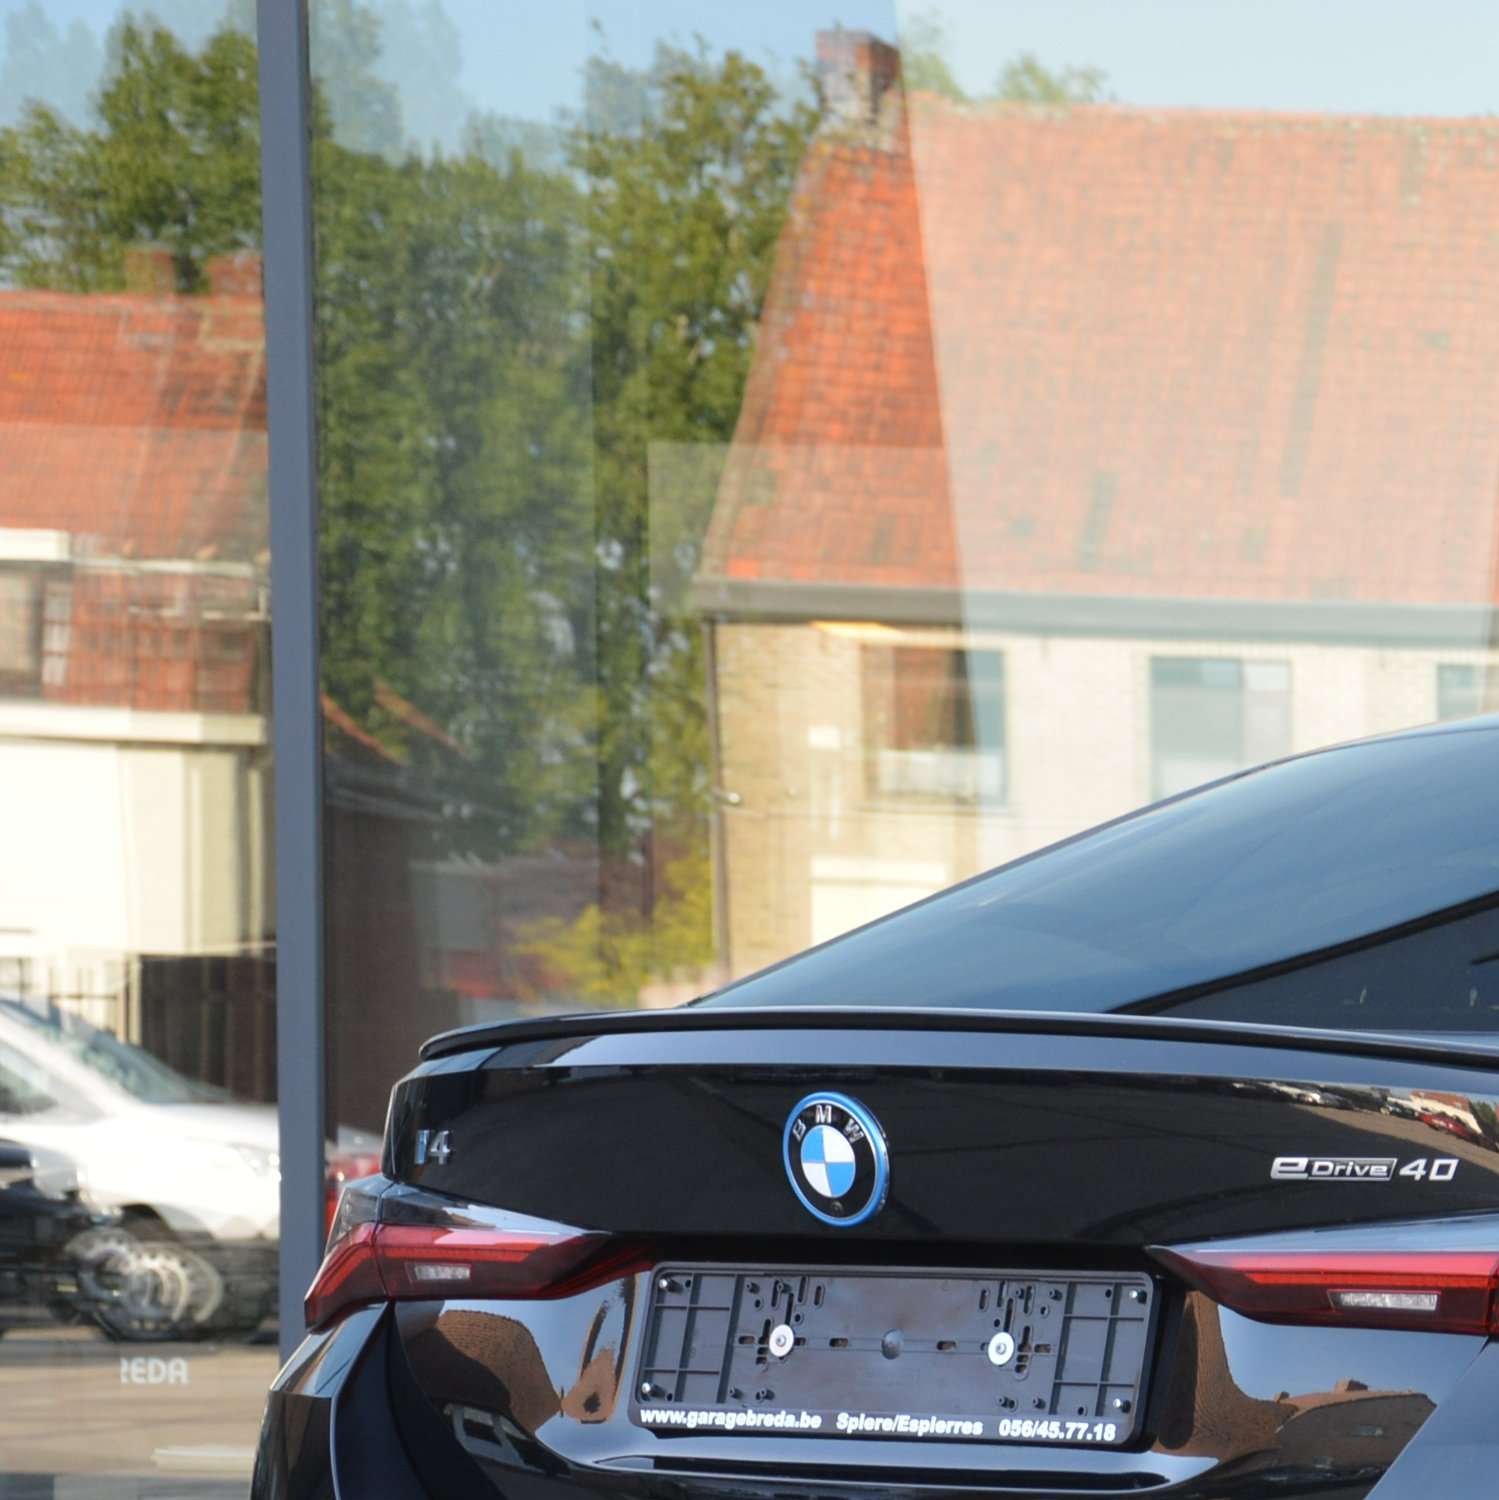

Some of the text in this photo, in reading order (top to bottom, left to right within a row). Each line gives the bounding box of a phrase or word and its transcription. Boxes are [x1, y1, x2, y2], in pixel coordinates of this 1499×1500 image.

[792, 1104, 865, 1144] BMW
[1270, 1157, 1460, 1182] eDrive 40
[640, 1409, 822, 1430] www.garagebreda.be
[998, 1418, 1117, 1442] 056/45.77.18
